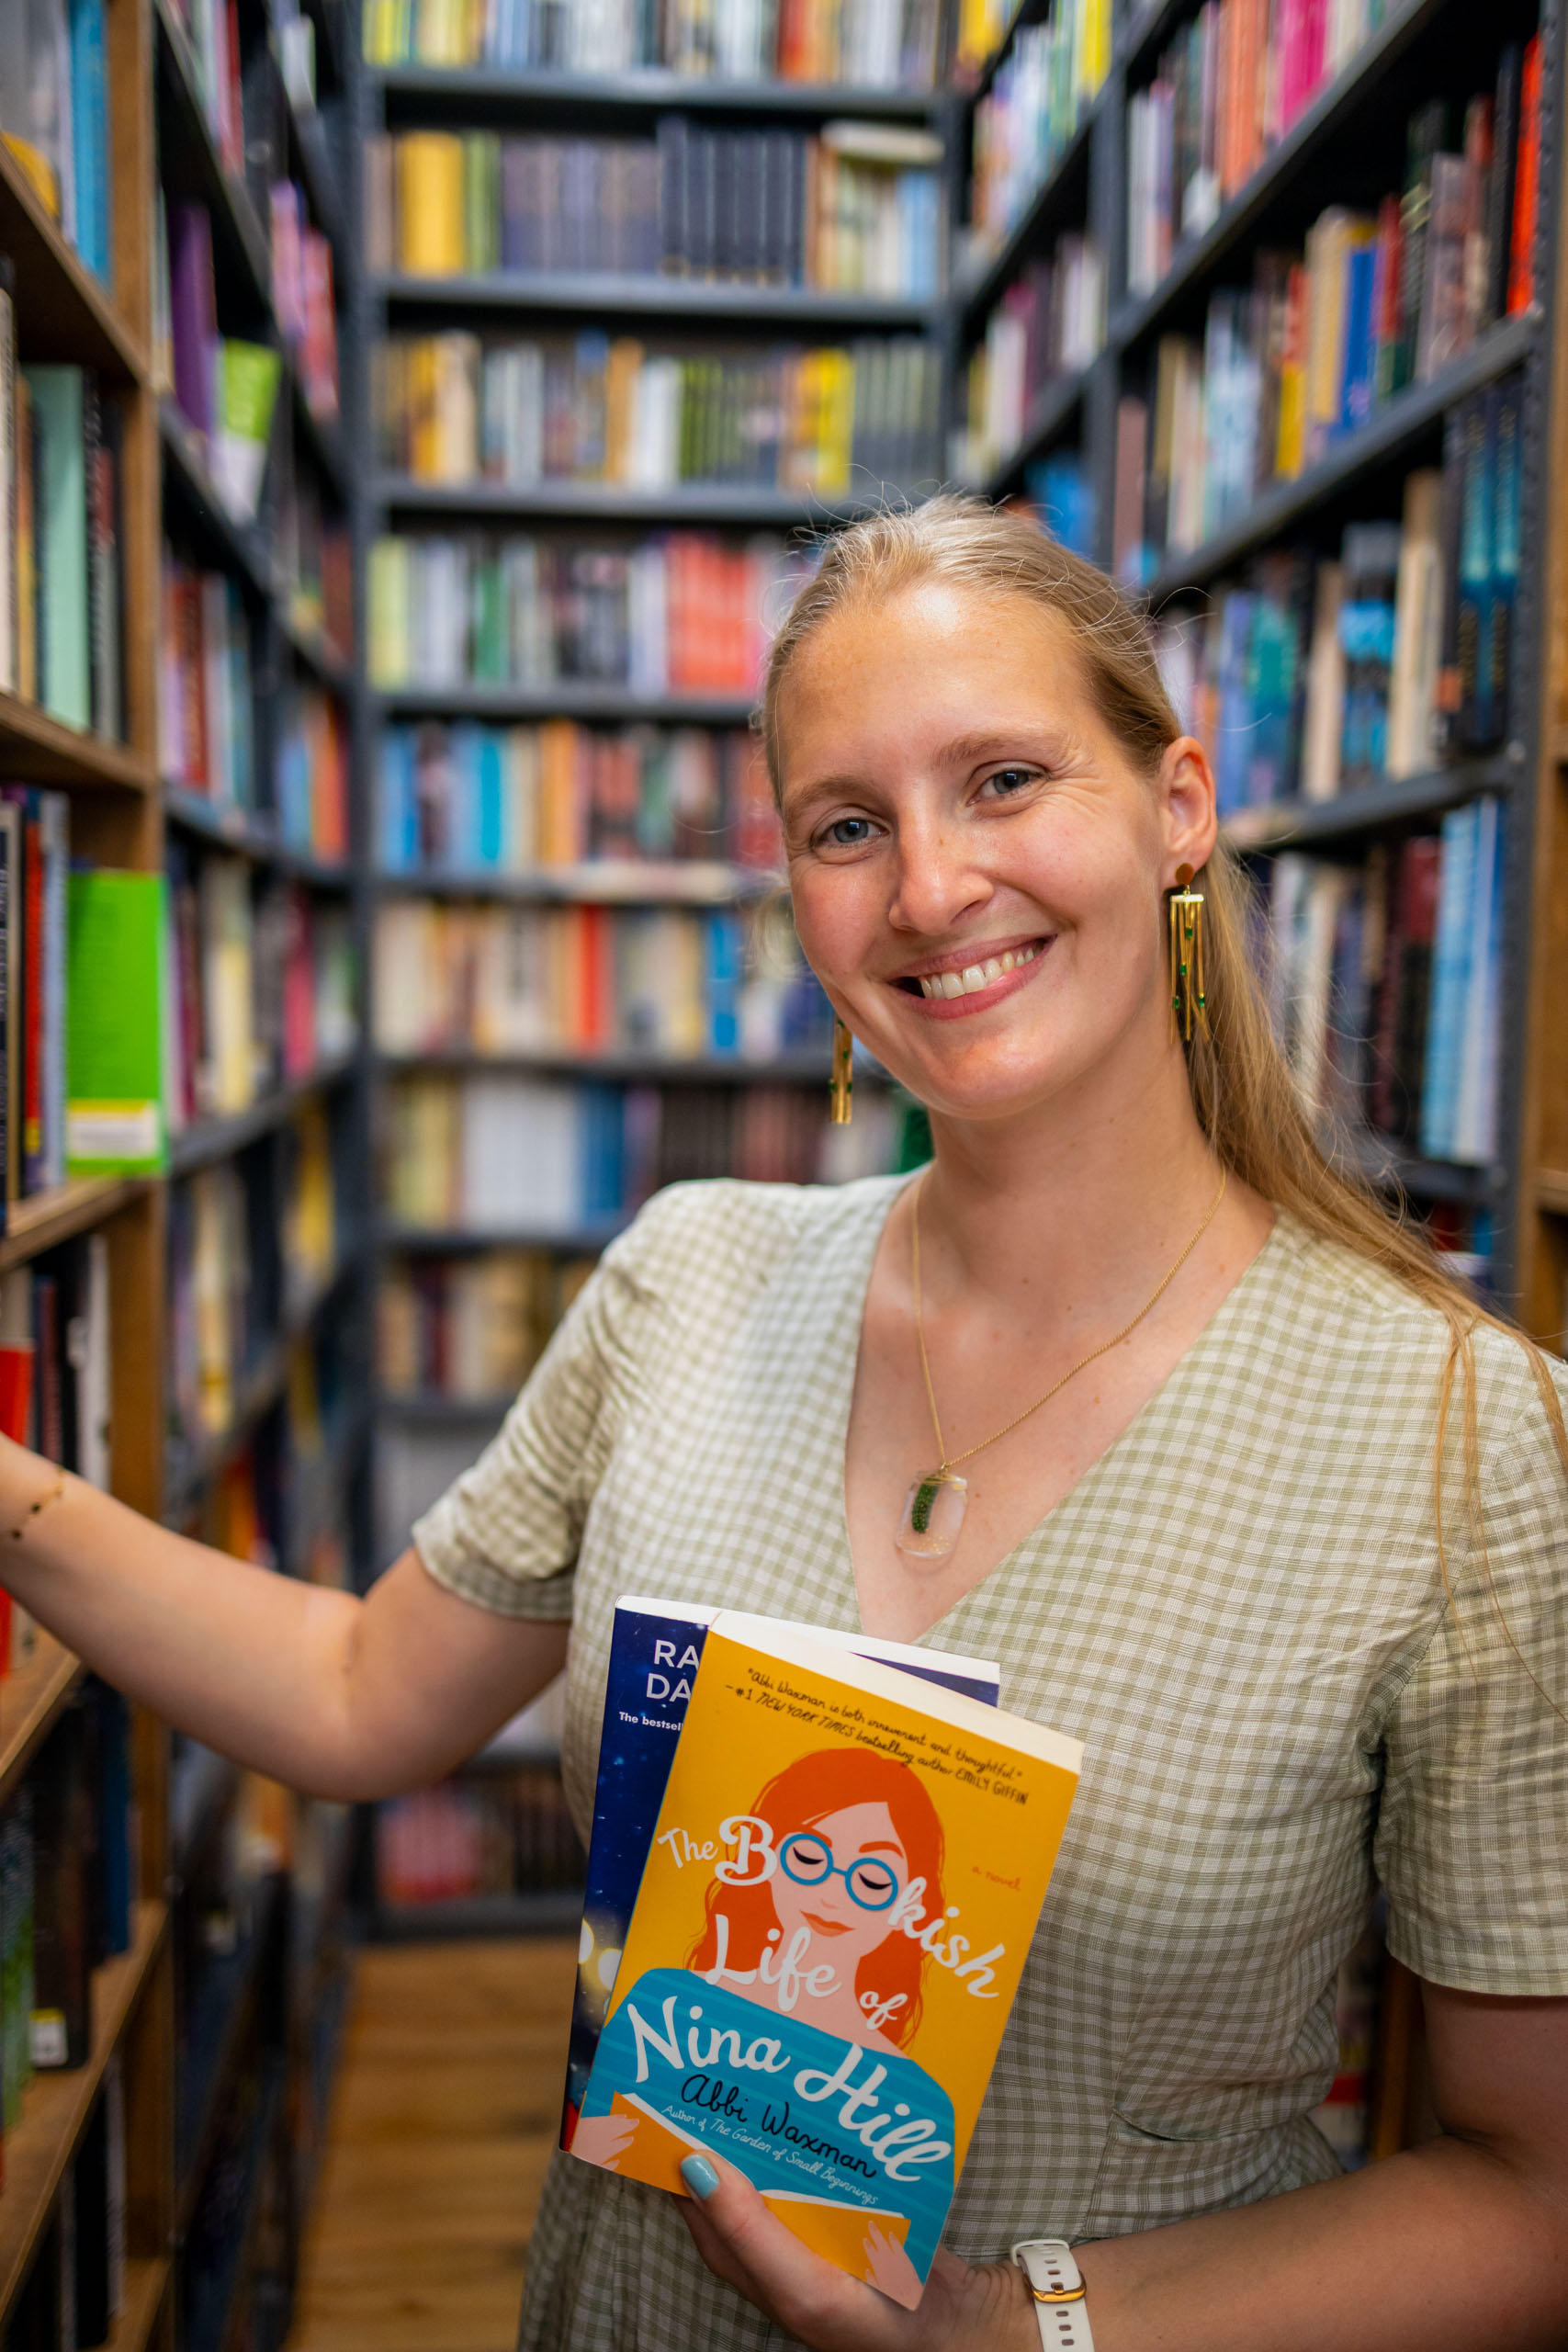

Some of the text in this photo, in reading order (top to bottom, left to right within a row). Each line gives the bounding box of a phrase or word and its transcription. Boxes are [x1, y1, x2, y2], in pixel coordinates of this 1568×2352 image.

[619, 1711, 638, 1724] The
[757, 1692, 786, 1712] NEW
[788, 1704, 817, 1723] YORK
[818, 1716, 855, 1736] TIMES
[856, 1730, 915, 1767] bestselling
[918, 1757, 953, 1775] author
[955, 1769, 990, 1791] EMILY
[993, 1781, 1030, 1805] GIFFIN
[777, 1680, 825, 1708] Waxman
[829, 1702, 839, 1713] is
[840, 1705, 864, 1723] both
[868, 1719, 927, 1746] irreverent
[931, 1742, 951, 1757] and
[657, 1827, 718, 1869] The
[986, 1871, 1021, 1891] novel
[705, 1914, 908, 2030] Life of
[626, 1996, 952, 2181] Nina Hill
[681, 2074, 877, 2177] Abbi Waxman
[661, 2105, 879, 2205] Author of The Garden of Small Beginnings
